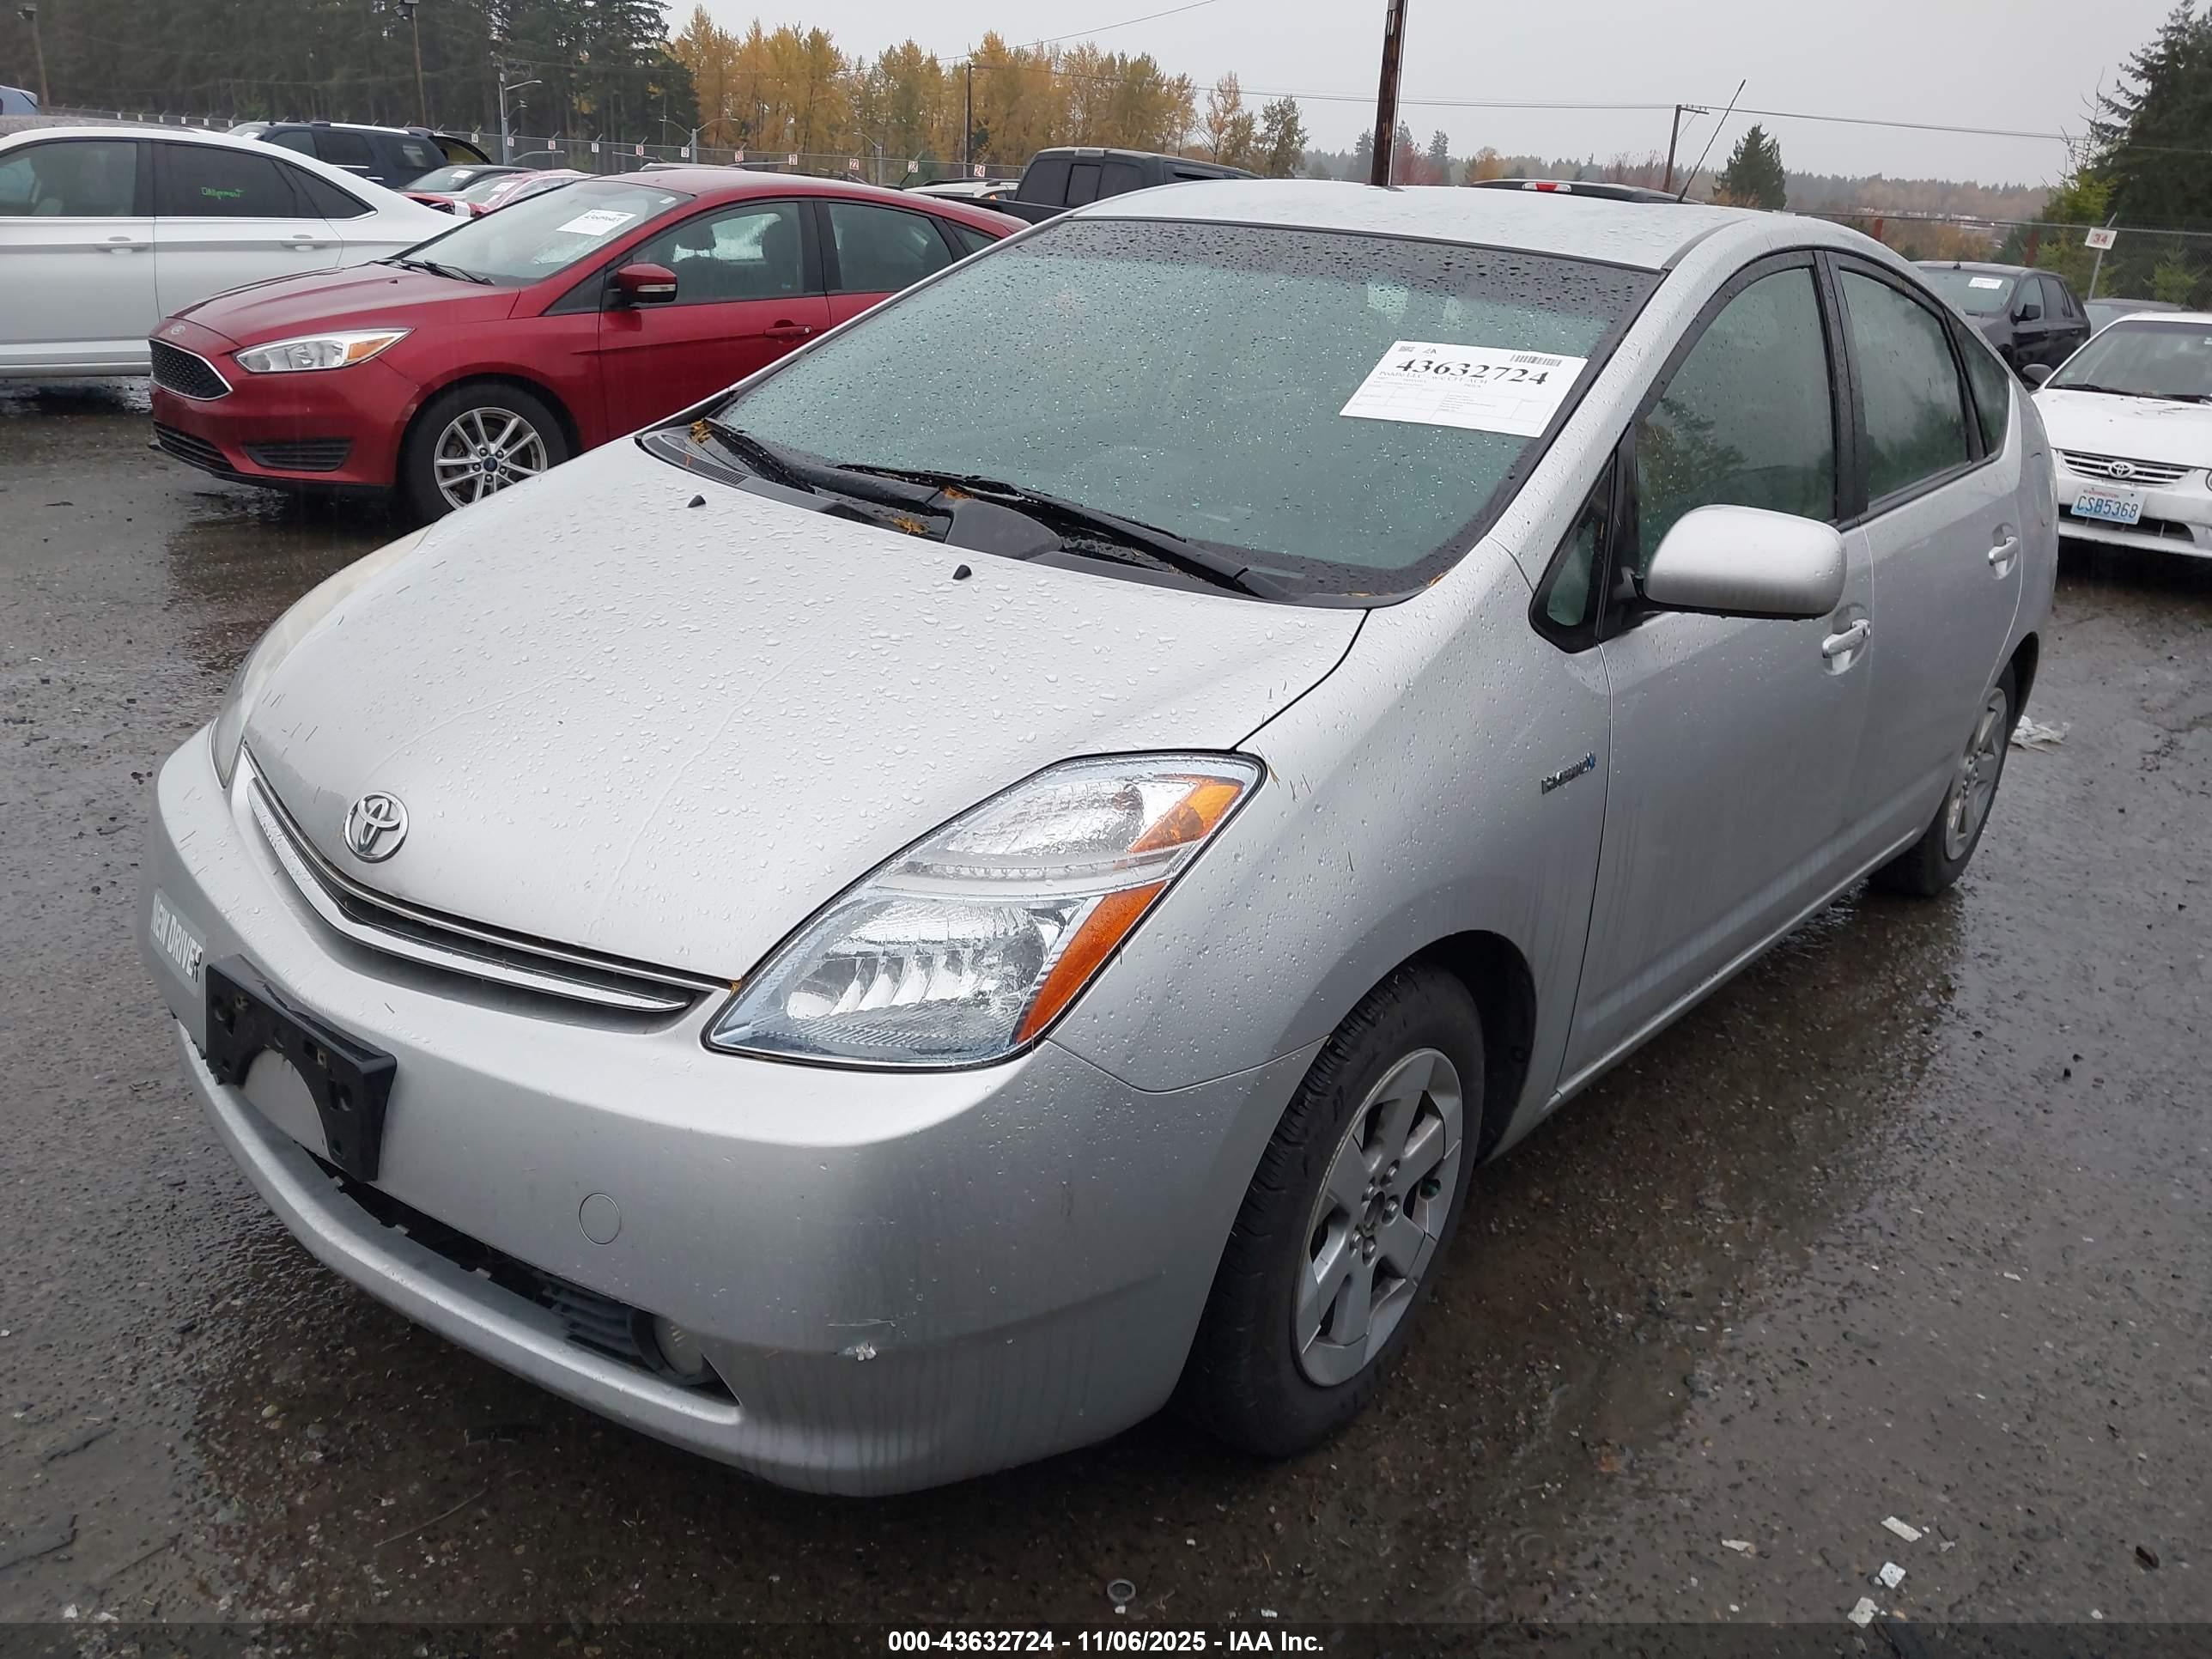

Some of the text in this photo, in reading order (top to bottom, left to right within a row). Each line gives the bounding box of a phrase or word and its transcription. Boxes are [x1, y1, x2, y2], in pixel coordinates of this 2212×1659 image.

[975, 165, 984, 176] 24
[2093, 233, 2108, 245] 34
[1395, 358, 1550, 386] 43632724
[2076, 495, 2139, 519] CSB5368
[151, 893, 204, 983] NEW DRIVER
